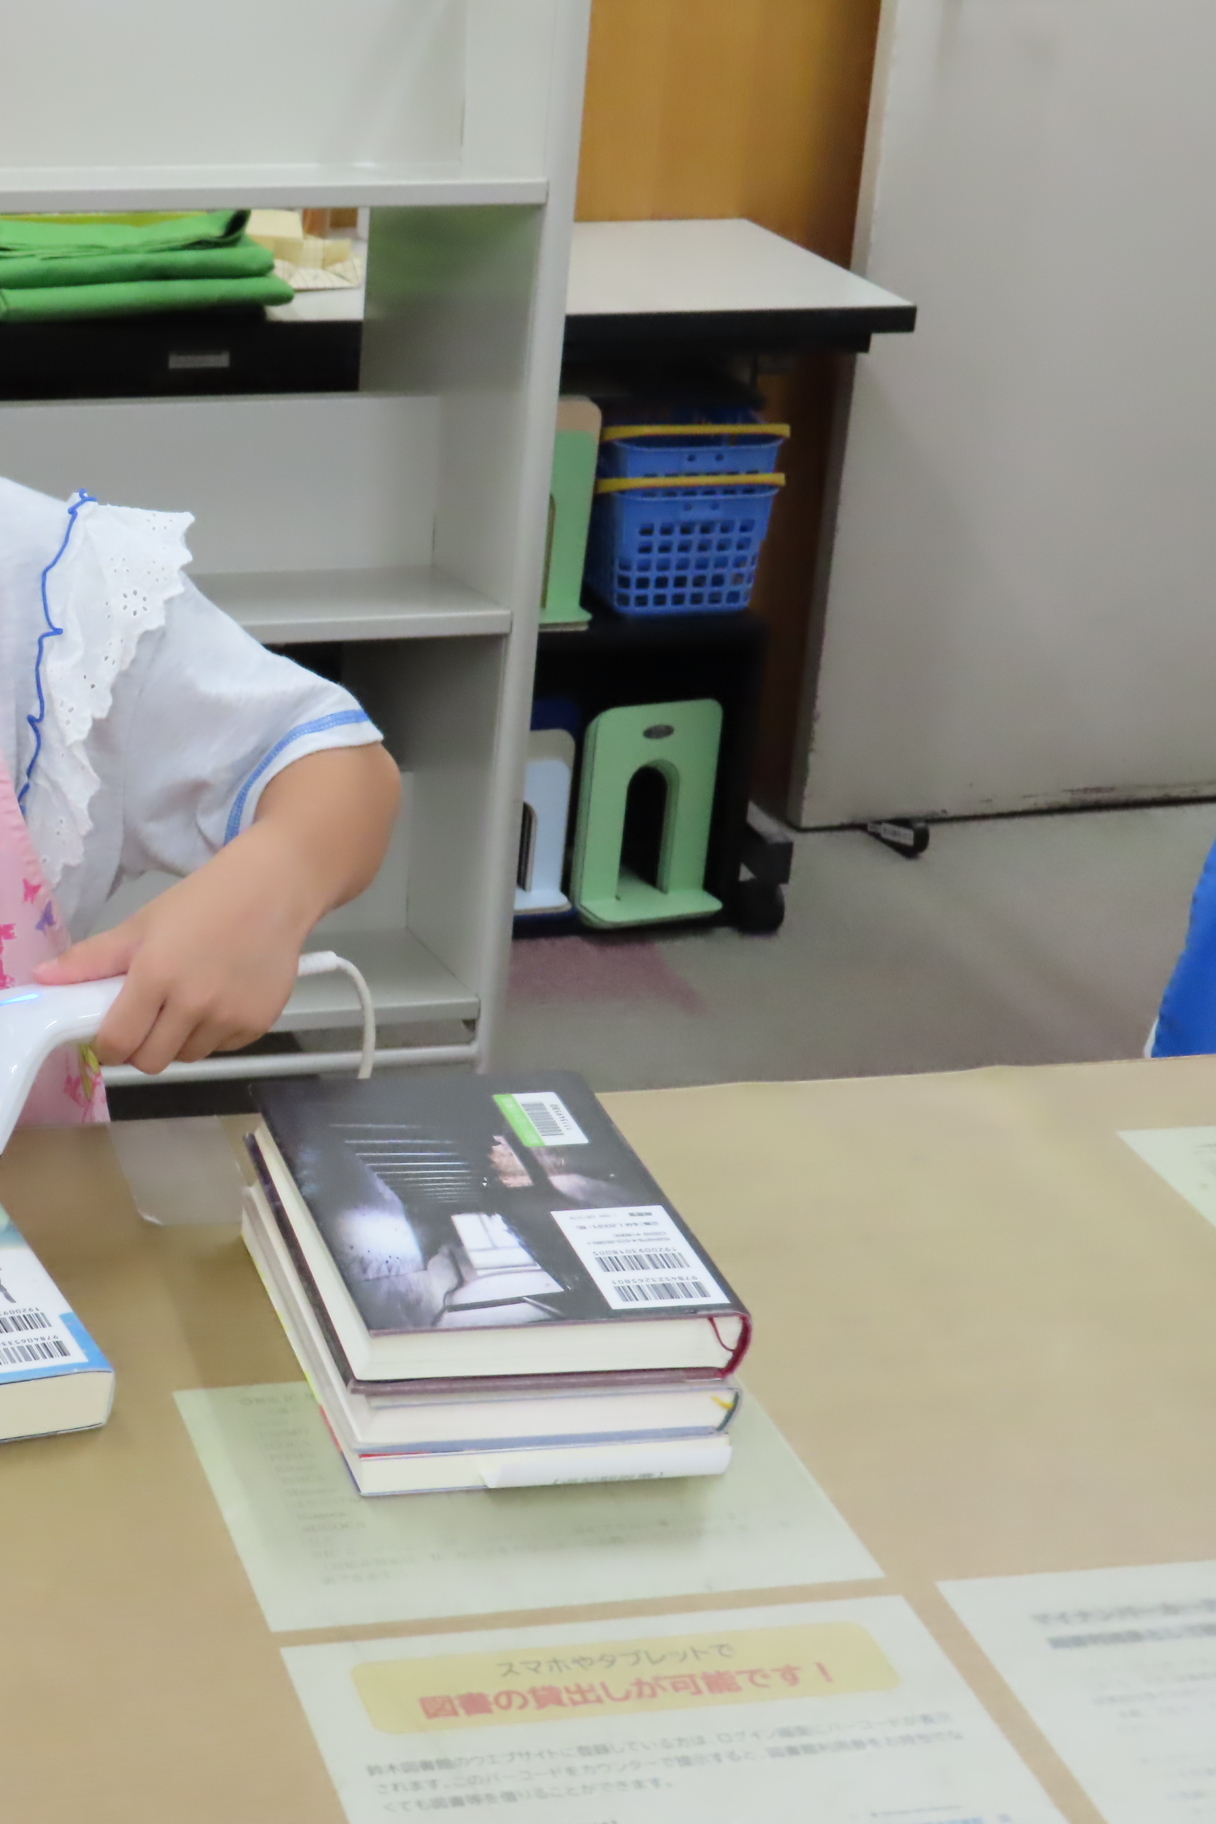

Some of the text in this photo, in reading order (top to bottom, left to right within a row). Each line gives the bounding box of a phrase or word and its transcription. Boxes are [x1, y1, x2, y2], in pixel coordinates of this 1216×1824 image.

[496, 1642, 735, 1678] スマホやタブレットで
